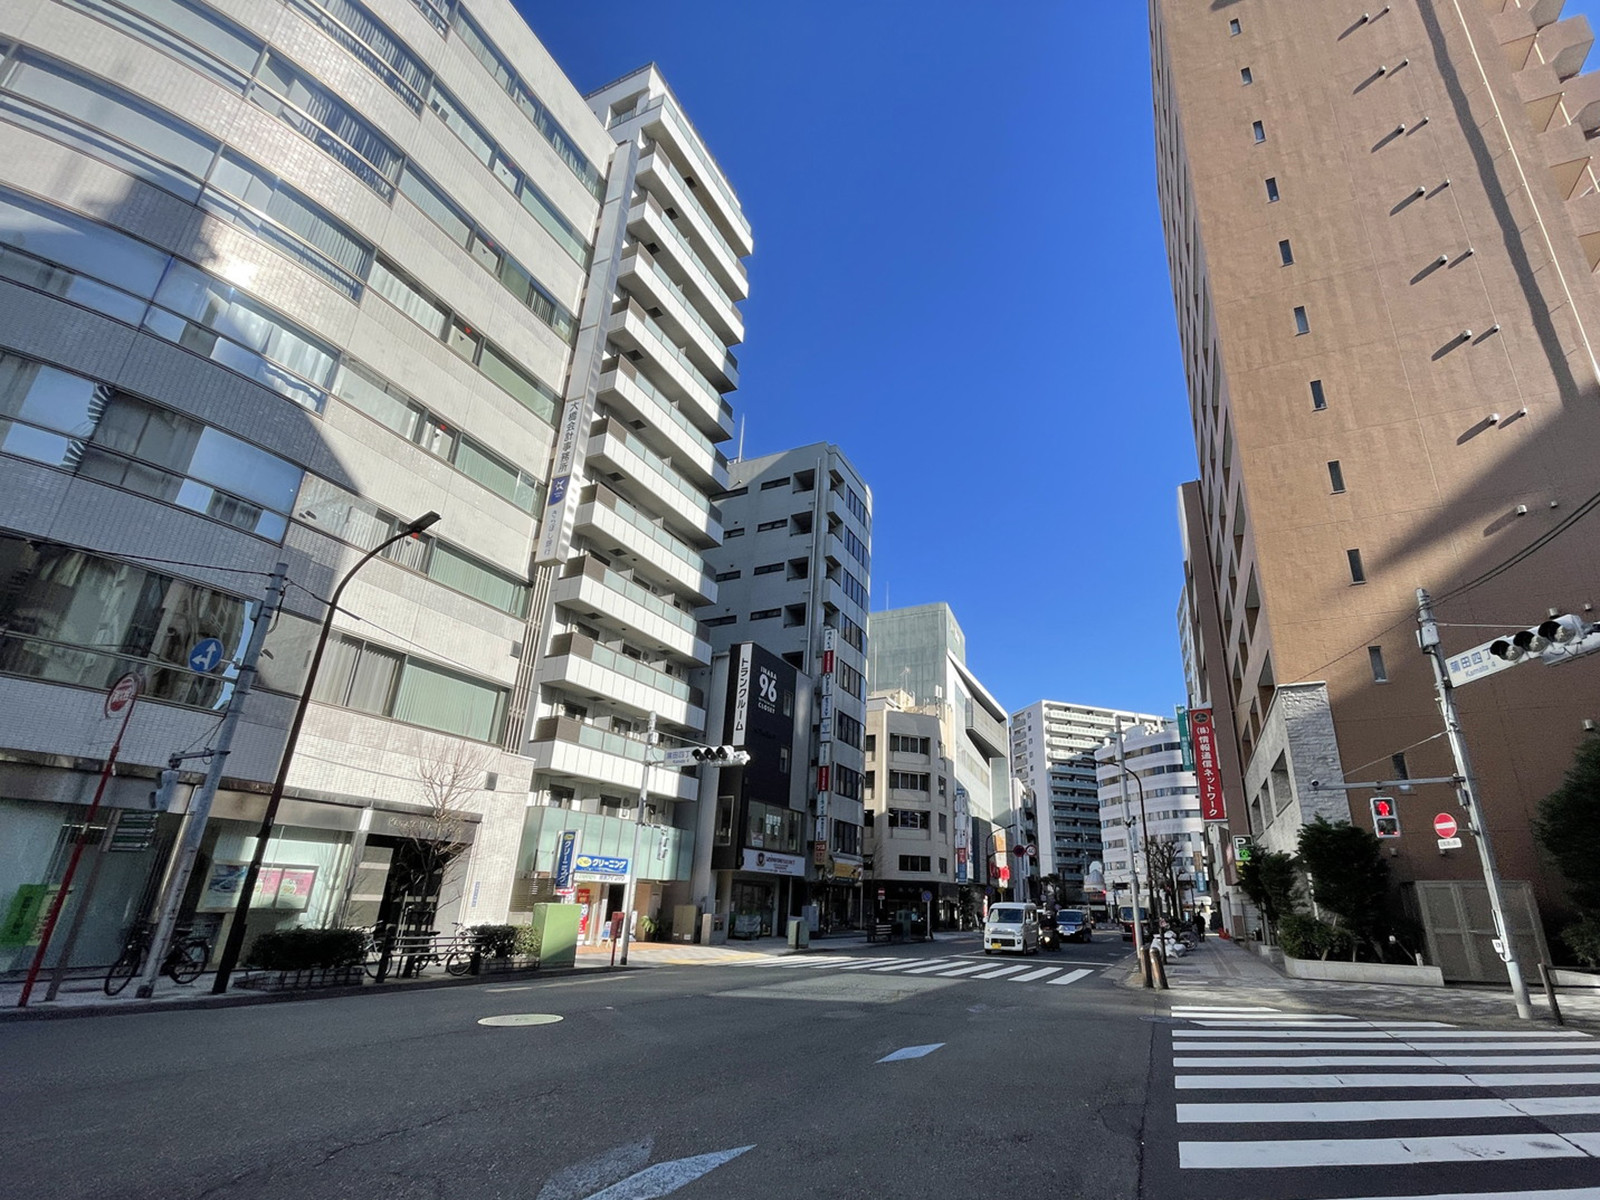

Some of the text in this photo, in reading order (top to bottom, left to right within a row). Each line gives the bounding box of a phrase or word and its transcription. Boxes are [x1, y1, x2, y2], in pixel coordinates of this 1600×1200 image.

[1450, 647, 1491, 673] 蒲田四丁
[1465, 664, 1489, 678] Kamata
[735, 657, 749, 731] トランクルーム
[759, 673, 777, 703] 96
[757, 702, 776, 714] CLOSET
[667, 751, 691, 759] 蒲田四丁
[1234, 837, 1247, 849] P
[559, 841, 571, 882] クリーニング
[592, 858, 627, 869] クリーニング
